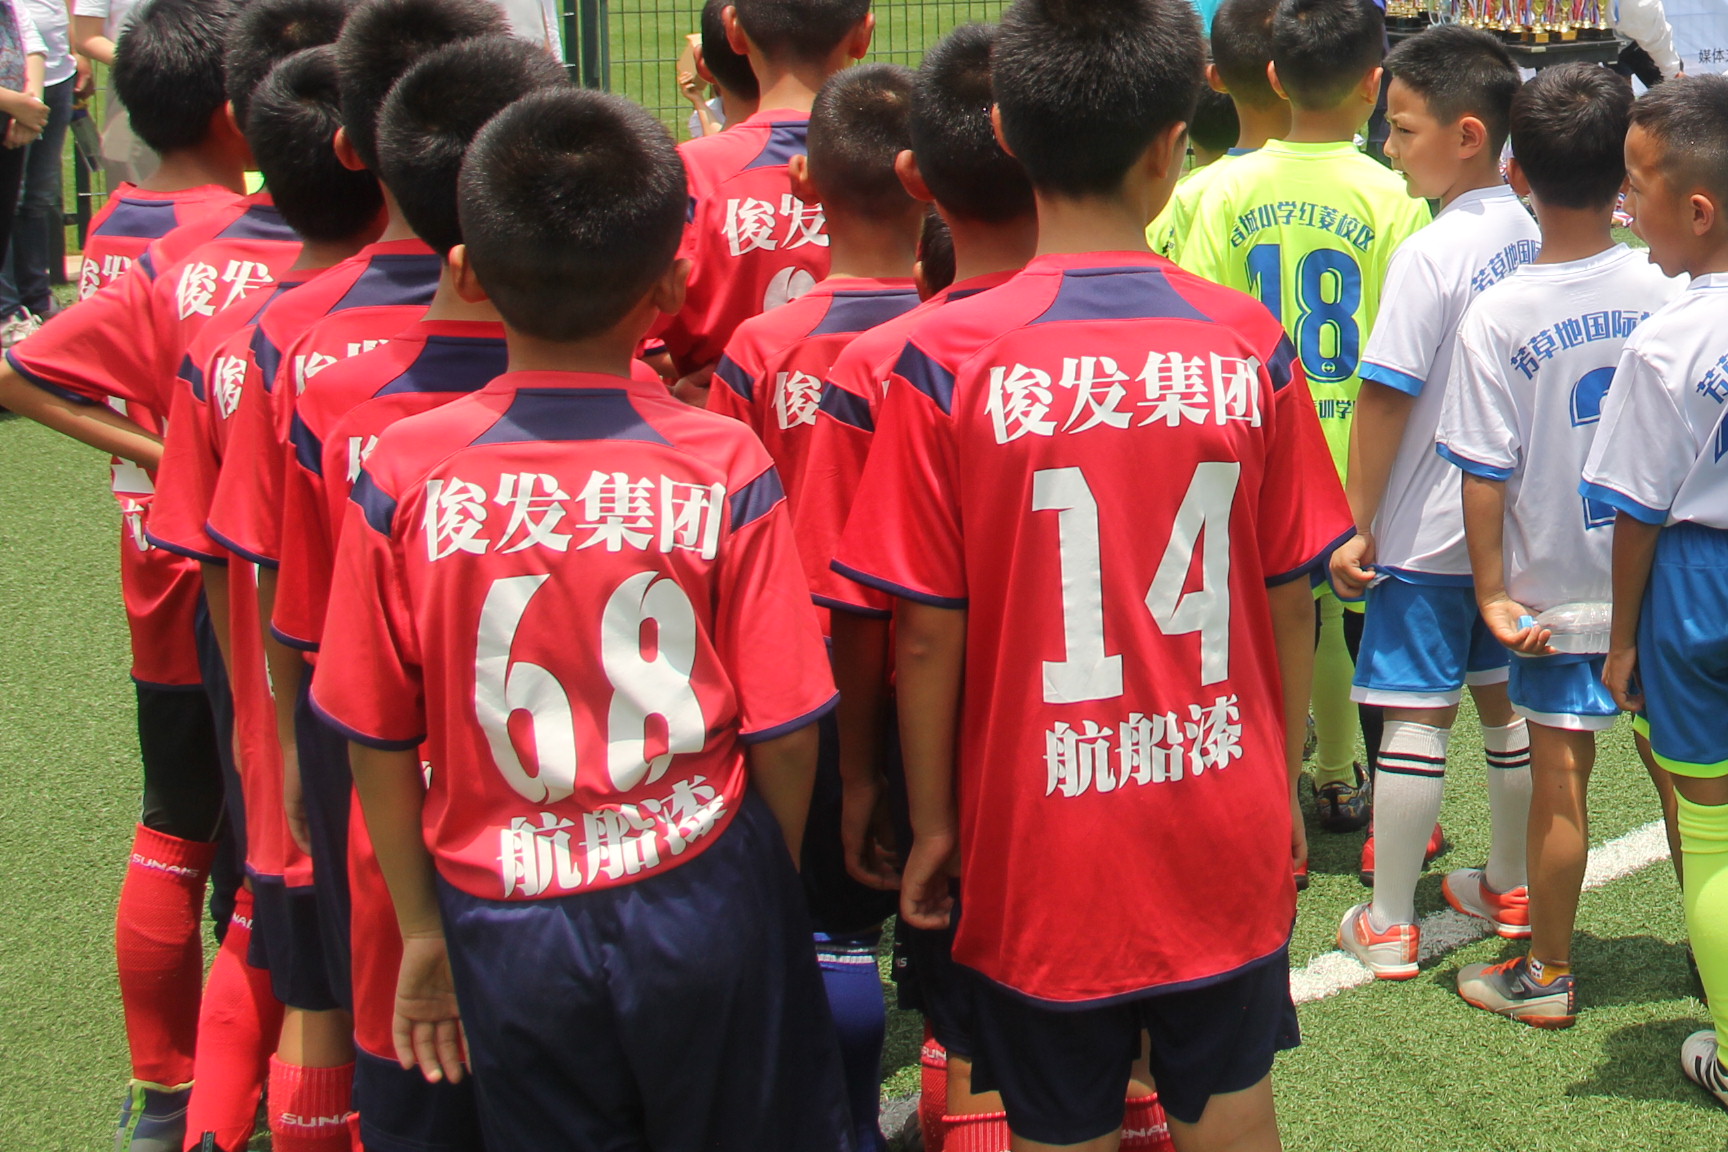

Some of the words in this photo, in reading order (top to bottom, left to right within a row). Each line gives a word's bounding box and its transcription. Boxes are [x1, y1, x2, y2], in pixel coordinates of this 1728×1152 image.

[721, 193, 830, 257] 俊发
[1245, 243, 1362, 383] 18
[1510, 309, 1654, 381] 芳草地国际
[984, 350, 1262, 445] 俊发集团
[419, 469, 727, 562] 俊发集团
[1032, 461, 1241, 705] 14
[475, 570, 706, 805] 68
[1043, 693, 1244, 799] 航船漆
[495, 774, 728, 898] 航船漆
